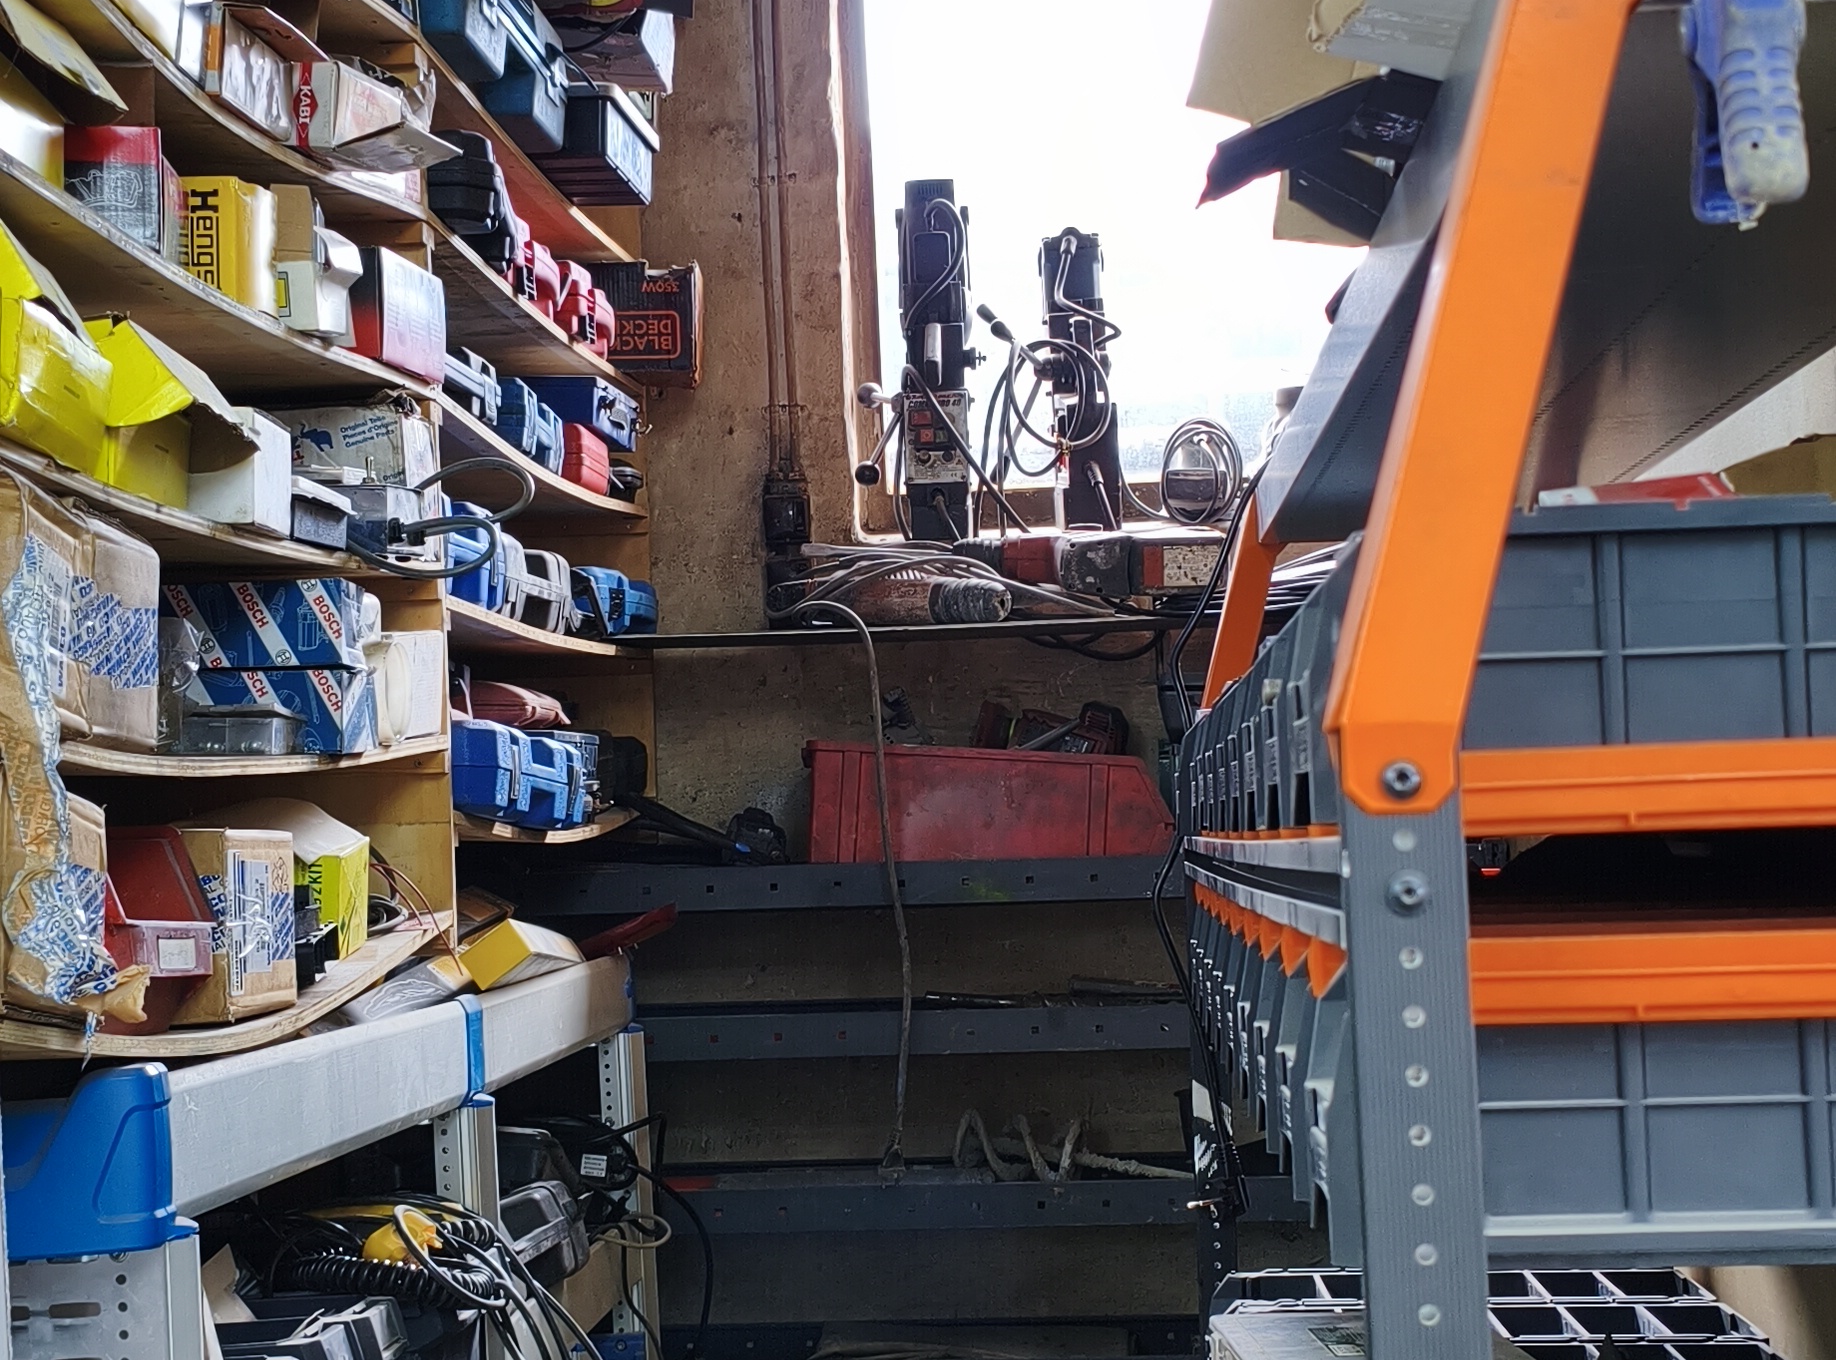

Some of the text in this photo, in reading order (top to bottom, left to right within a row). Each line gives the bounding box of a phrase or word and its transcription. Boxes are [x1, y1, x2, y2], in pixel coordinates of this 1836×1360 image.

[298, 85, 312, 125] KABI
[190, 189, 220, 290] Hengs
[616, 320, 672, 335] DECK
[168, 585, 195, 619] OSCH
[236, 583, 270, 629] BOSCH
[312, 595, 343, 640] BOSCH
[247, 672, 269, 699] SCH
[311, 669, 343, 713] BOSCH
